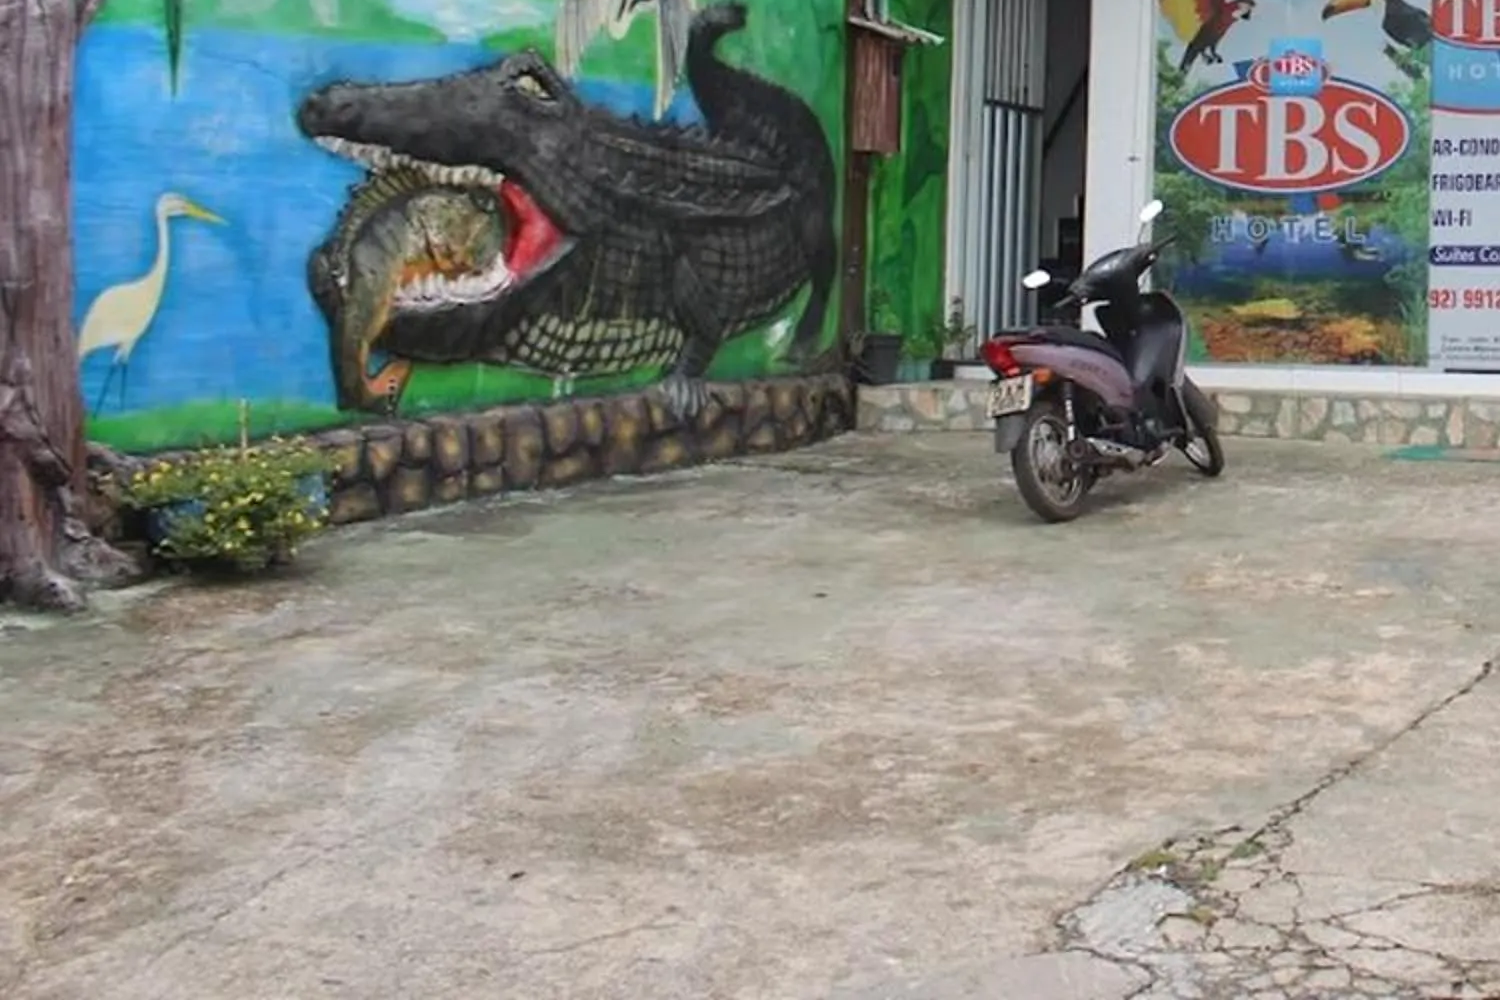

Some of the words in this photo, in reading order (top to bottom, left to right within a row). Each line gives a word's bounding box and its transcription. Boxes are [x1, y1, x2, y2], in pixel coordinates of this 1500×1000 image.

[1277, 54, 1315, 75] TBS
[1200, 95, 1380, 180] TBS
[1211, 215, 1366, 243] HOTEL
[1432, 209, 1473, 228] WI-FI
